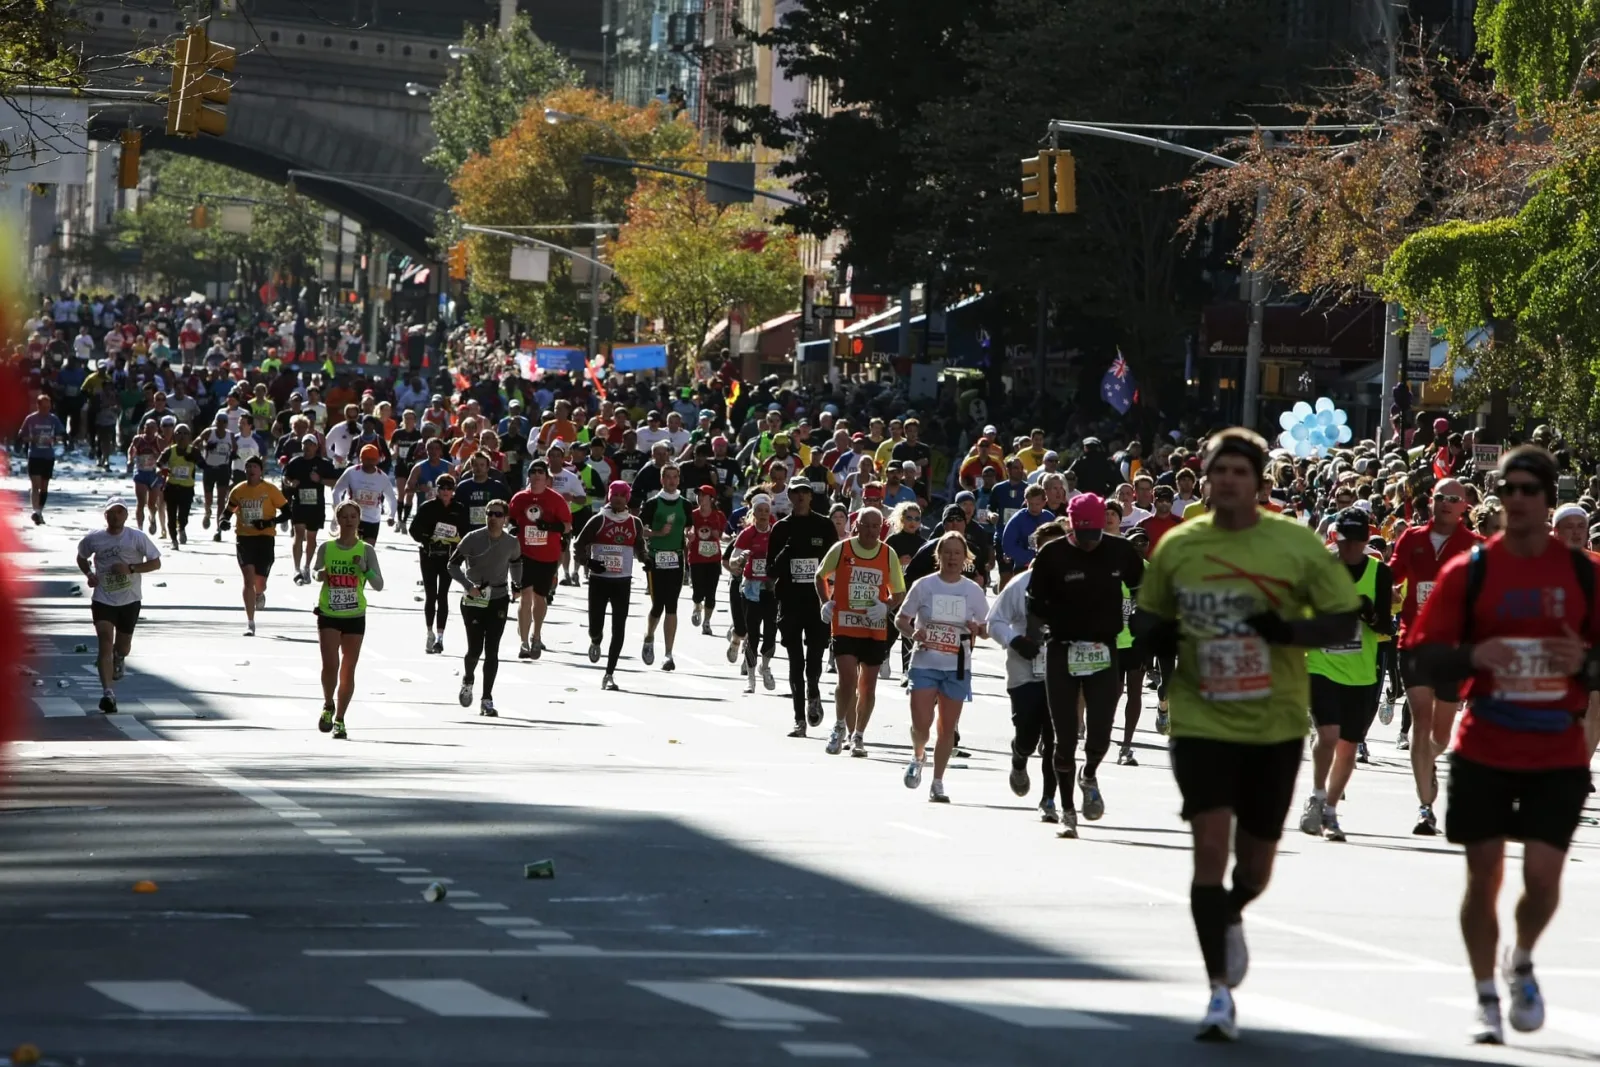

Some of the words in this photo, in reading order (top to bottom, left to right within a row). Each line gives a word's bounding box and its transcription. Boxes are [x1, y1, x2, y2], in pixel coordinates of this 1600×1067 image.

[1475, 453, 1498, 461] TEAM
[606, 526, 633, 540] ITALIA
[794, 564, 817, 573] 25-234
[852, 570, 881, 583] MERV
[332, 595, 355, 603] 22-345
[936, 599, 963, 617] SUE
[846, 614, 863, 626] FOR
[928, 631, 956, 644] 15-253
